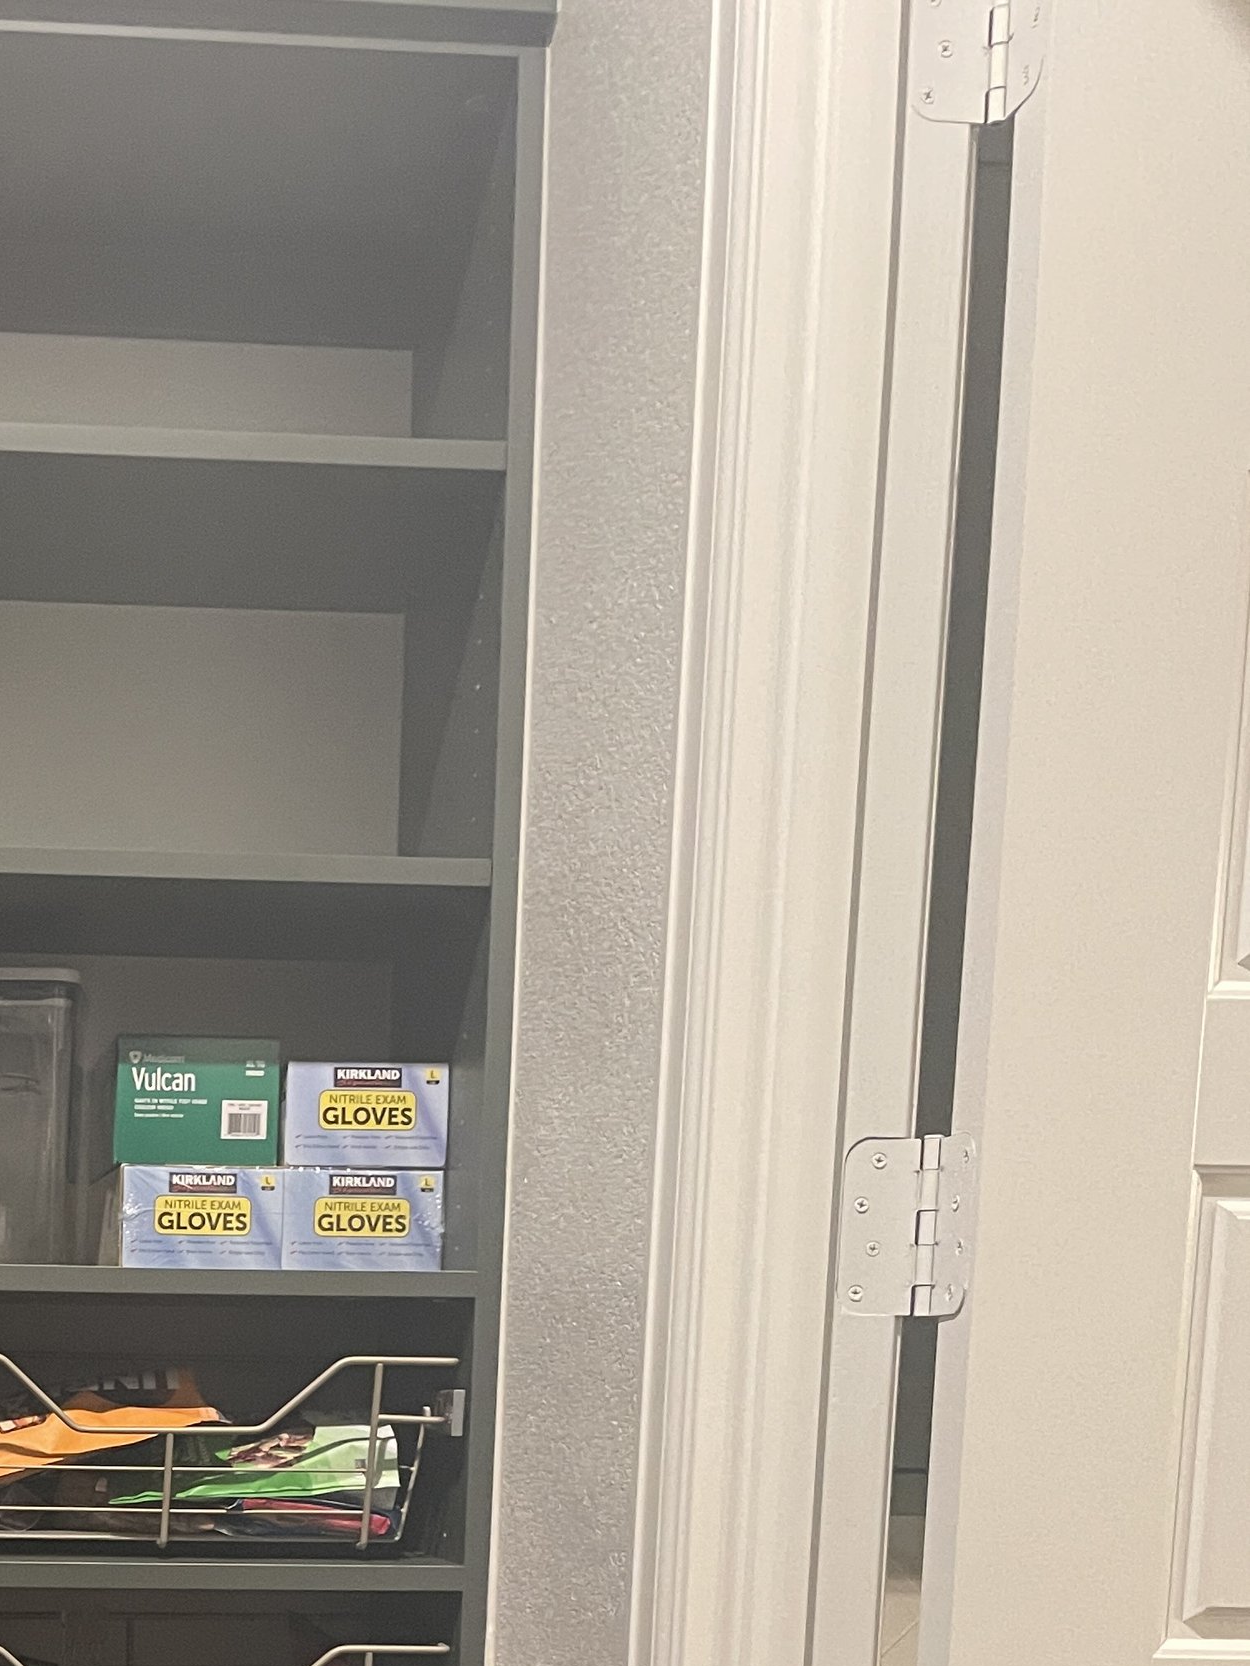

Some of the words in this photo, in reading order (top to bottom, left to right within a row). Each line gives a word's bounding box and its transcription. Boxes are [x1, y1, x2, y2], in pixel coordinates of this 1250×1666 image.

[131, 1066, 196, 1092] Vulcan
[337, 1068, 401, 1080] KIRKLAND
[329, 1094, 372, 1104] NITRILE
[375, 1094, 407, 1104] EXAM
[322, 1106, 413, 1126] GLOVES
[172, 1173, 235, 1186] KIRKLAND
[332, 1175, 395, 1188] KIRKLAND
[164, 1199, 207, 1209] NITRILE
[210, 1199, 241, 1210] EXAM
[324, 1201, 367, 1212] NITRILE
[370, 1202, 401, 1212] EXAM
[157, 1211, 248, 1231] GLOVES
[317, 1213, 407, 1233] GLOVES
